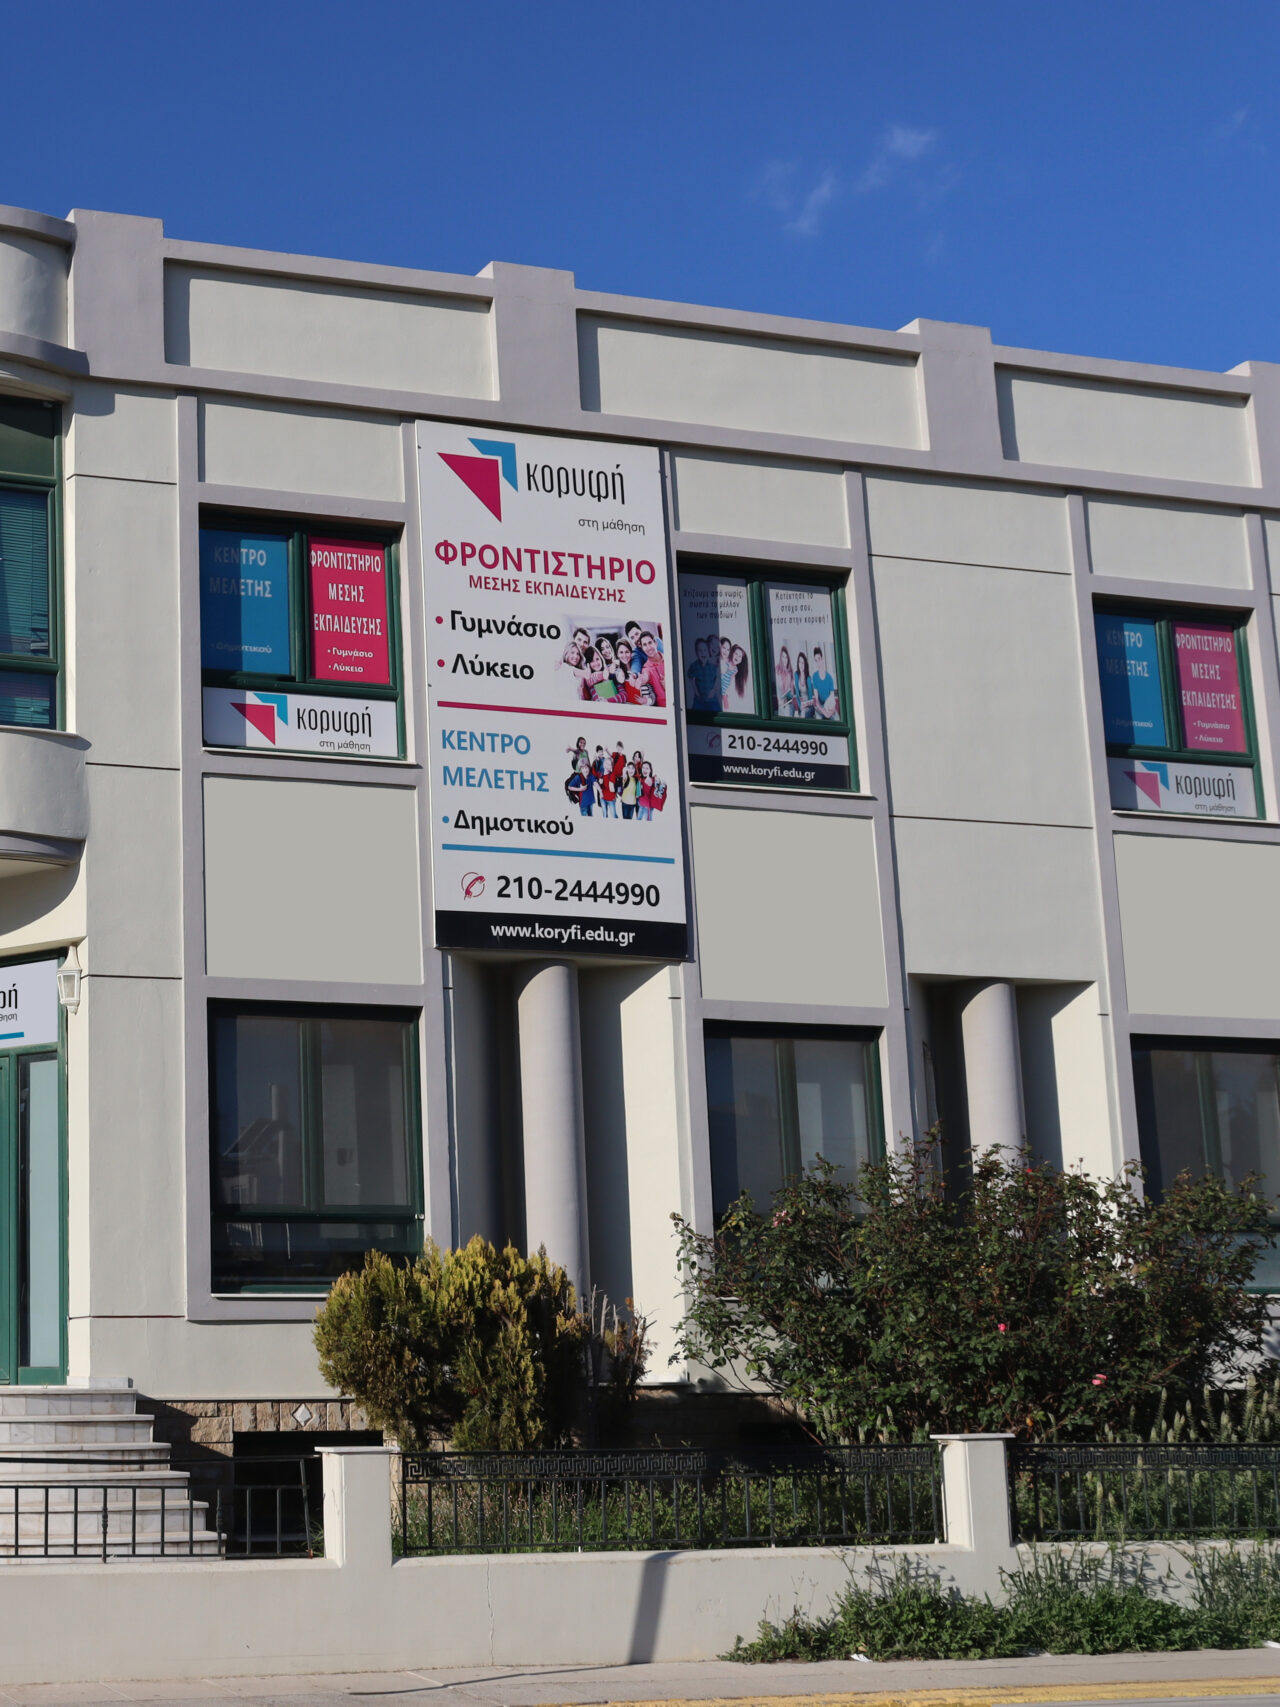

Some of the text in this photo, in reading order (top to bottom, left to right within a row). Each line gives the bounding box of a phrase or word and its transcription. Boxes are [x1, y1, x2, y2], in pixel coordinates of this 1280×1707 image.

[526, 464, 625, 504] κορυφή
[578, 517, 645, 535] στη μάθηση
[214, 548, 267, 567] ΚΕΝΤΡΟ
[310, 550, 382, 573] ΦΡΟΝΤΙΣΤΗΡΙΟ
[435, 540, 656, 585] ΦΡΟΝΤΙΣΤΗΡΙΟ
[210, 577, 272, 598] ΜΕΛΕΤΗΣ
[328, 583, 365, 603] ΜΕΣΗΣ
[469, 575, 626, 603] ΜΕΣΗΣ ΕΚΠΑΙΔΕΥΣΗΣ
[314, 613, 382, 636] ΕΚΠΑΙΔΕΥΣΗΣ
[450, 610, 561, 640] Γυμνάσιο
[332, 647, 374, 659] Γυμνάσιο
[1175, 633, 1232, 653] ΦΡΟΝΤΙΣΤΗΡΙΟ
[333, 662, 364, 673] Λύκειο
[451, 653, 534, 680] Λύκειο
[1191, 663, 1221, 680] ΜΕΣΗΣ
[1182, 690, 1237, 710] ΕΚΠΑΙΔΕΥΣΗΣ
[297, 706, 372, 738] κορυφή
[319, 739, 371, 752] στη μάθηση
[441, 729, 531, 755] ΚΕΝΤΡΟ
[728, 734, 828, 756] 210-2444990
[443, 766, 550, 792] ΜΕΛΕΤΗΣ
[723, 764, 815, 782] www.koryfi.edu.gr
[1175, 773, 1236, 800] κορυφή
[454, 809, 574, 836] Δημοτικού
[496, 875, 660, 907] 210-2444990
[491, 923, 636, 946] www.koryfi.edu.gr
